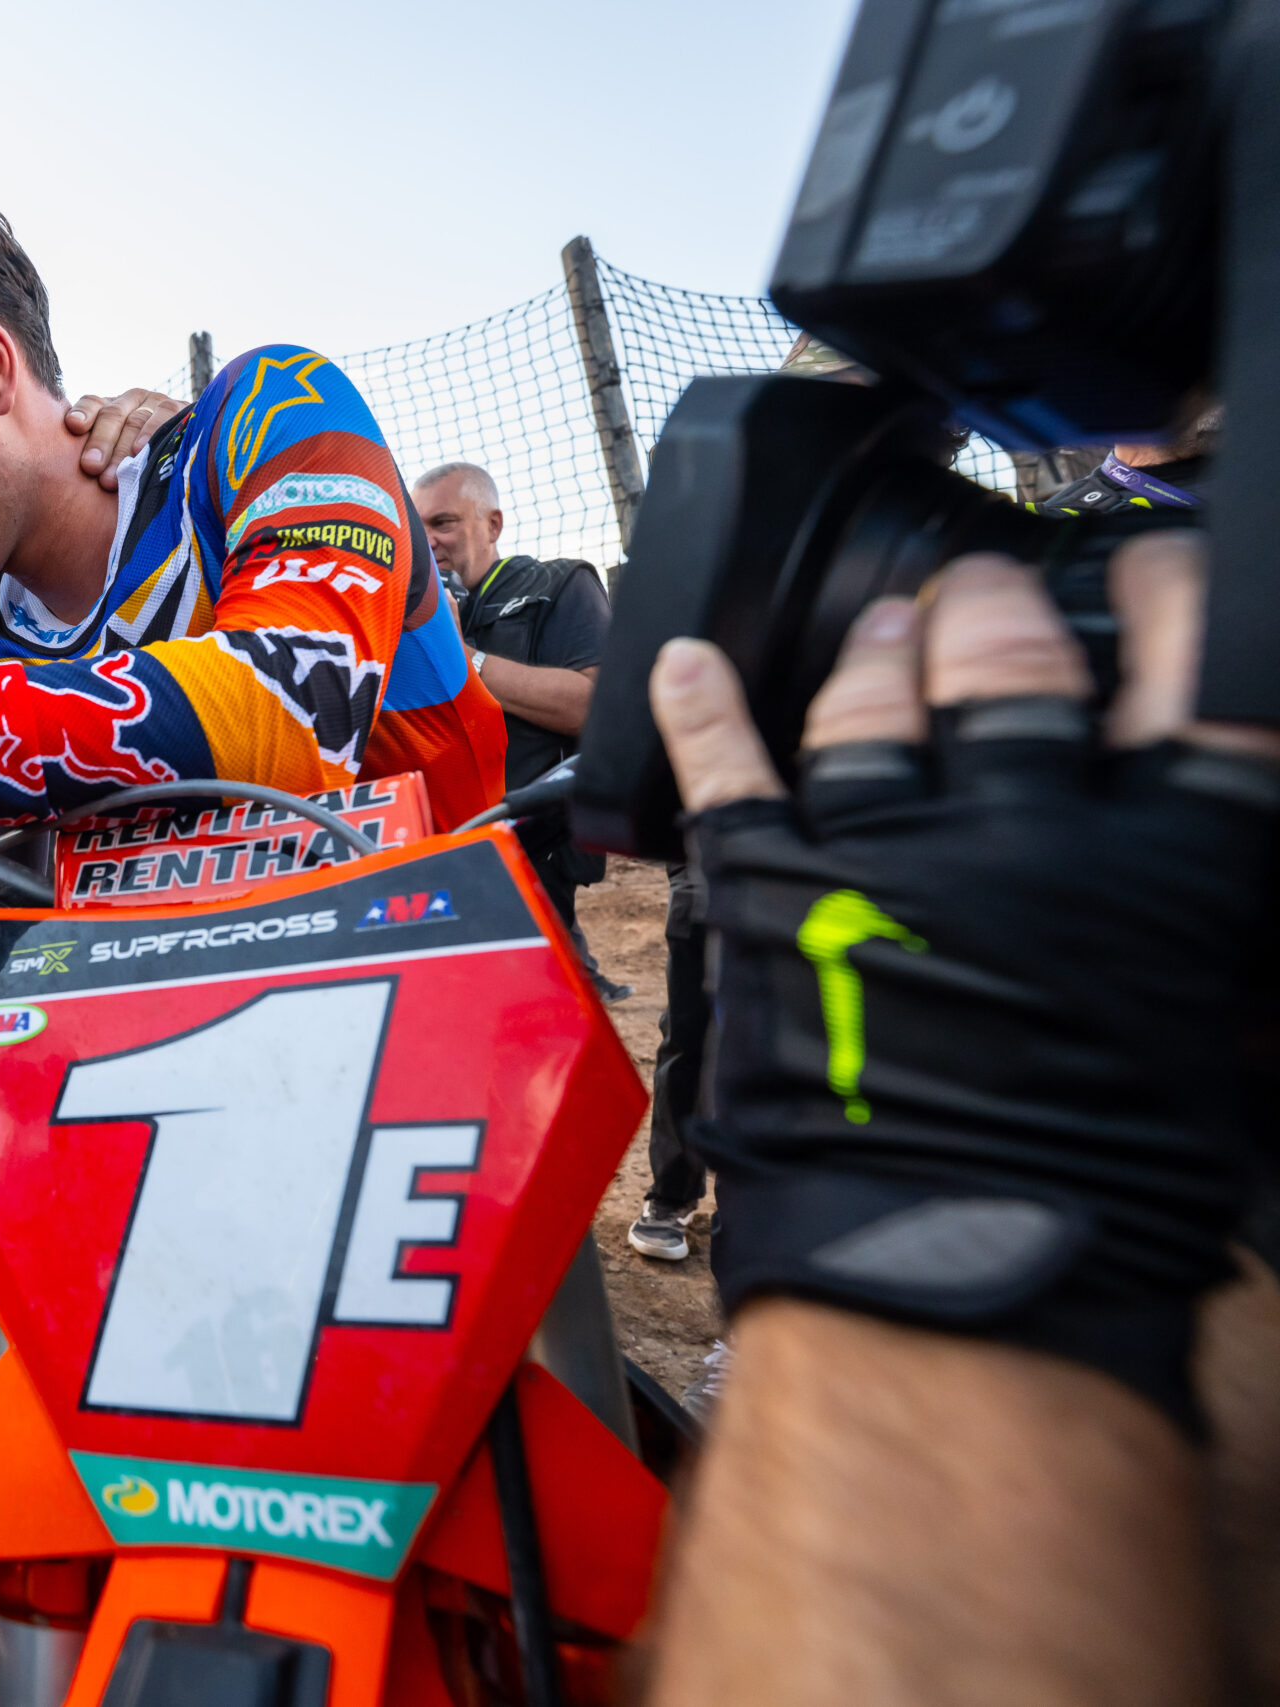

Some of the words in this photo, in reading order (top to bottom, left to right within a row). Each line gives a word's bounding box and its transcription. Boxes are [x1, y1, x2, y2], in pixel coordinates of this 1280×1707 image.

[255, 479, 390, 513] MOTOREX
[251, 558, 384, 594] WP
[71, 817, 404, 899] RENTHAL
[9, 947, 73, 976] SMX
[89, 909, 338, 964] SUPERCROSS
[356, 889, 457, 929] AMA
[167, 1479, 394, 1548] MOTOREX
